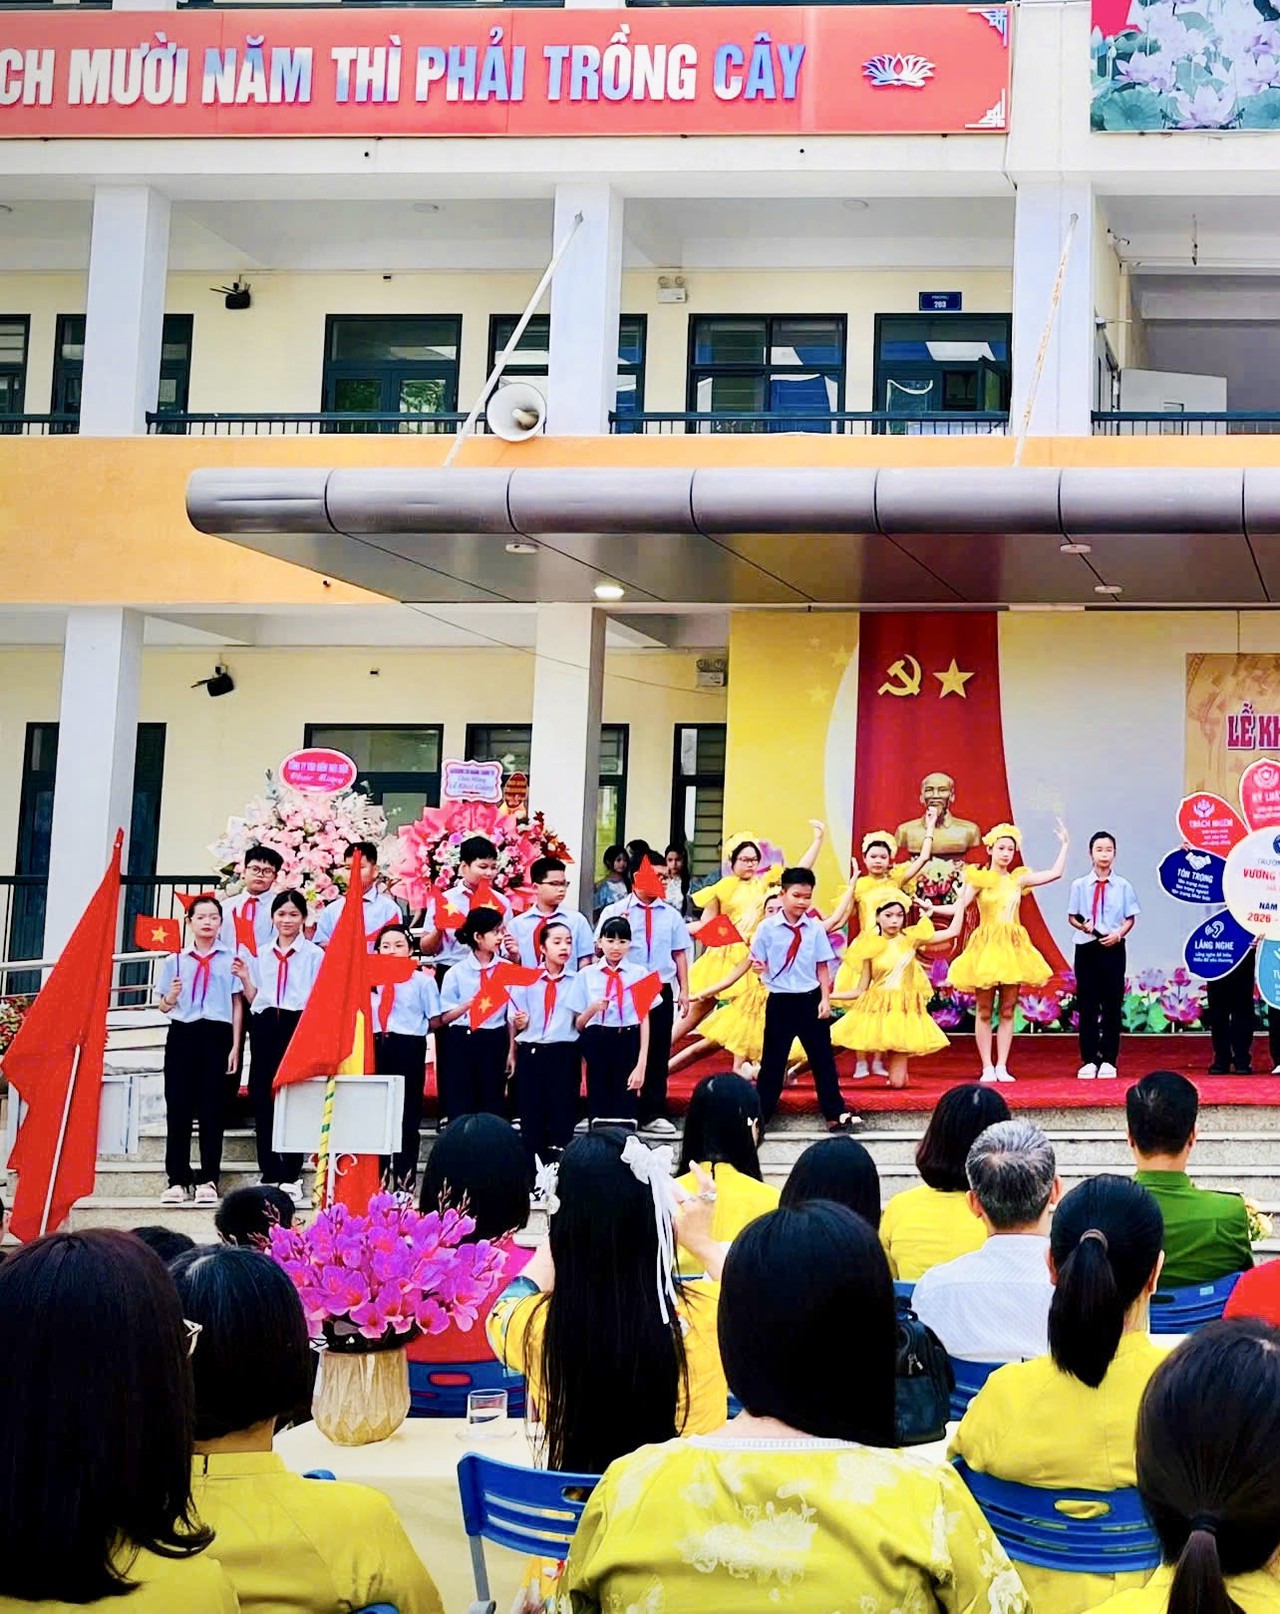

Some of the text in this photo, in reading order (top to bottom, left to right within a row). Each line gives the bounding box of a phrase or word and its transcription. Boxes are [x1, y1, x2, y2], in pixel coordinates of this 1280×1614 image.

[68, 32, 188, 105] MƯỜI
[202, 34, 313, 103] NĂM
[331, 34, 401, 102] THÌ
[415, 26, 526, 101] PHẢI
[543, 24, 698, 101] TRỒNG
[713, 31, 806, 100] CÂY
[1228, 703, 1254, 750] LỄ
[1215, 941, 1234, 950] NGHE
